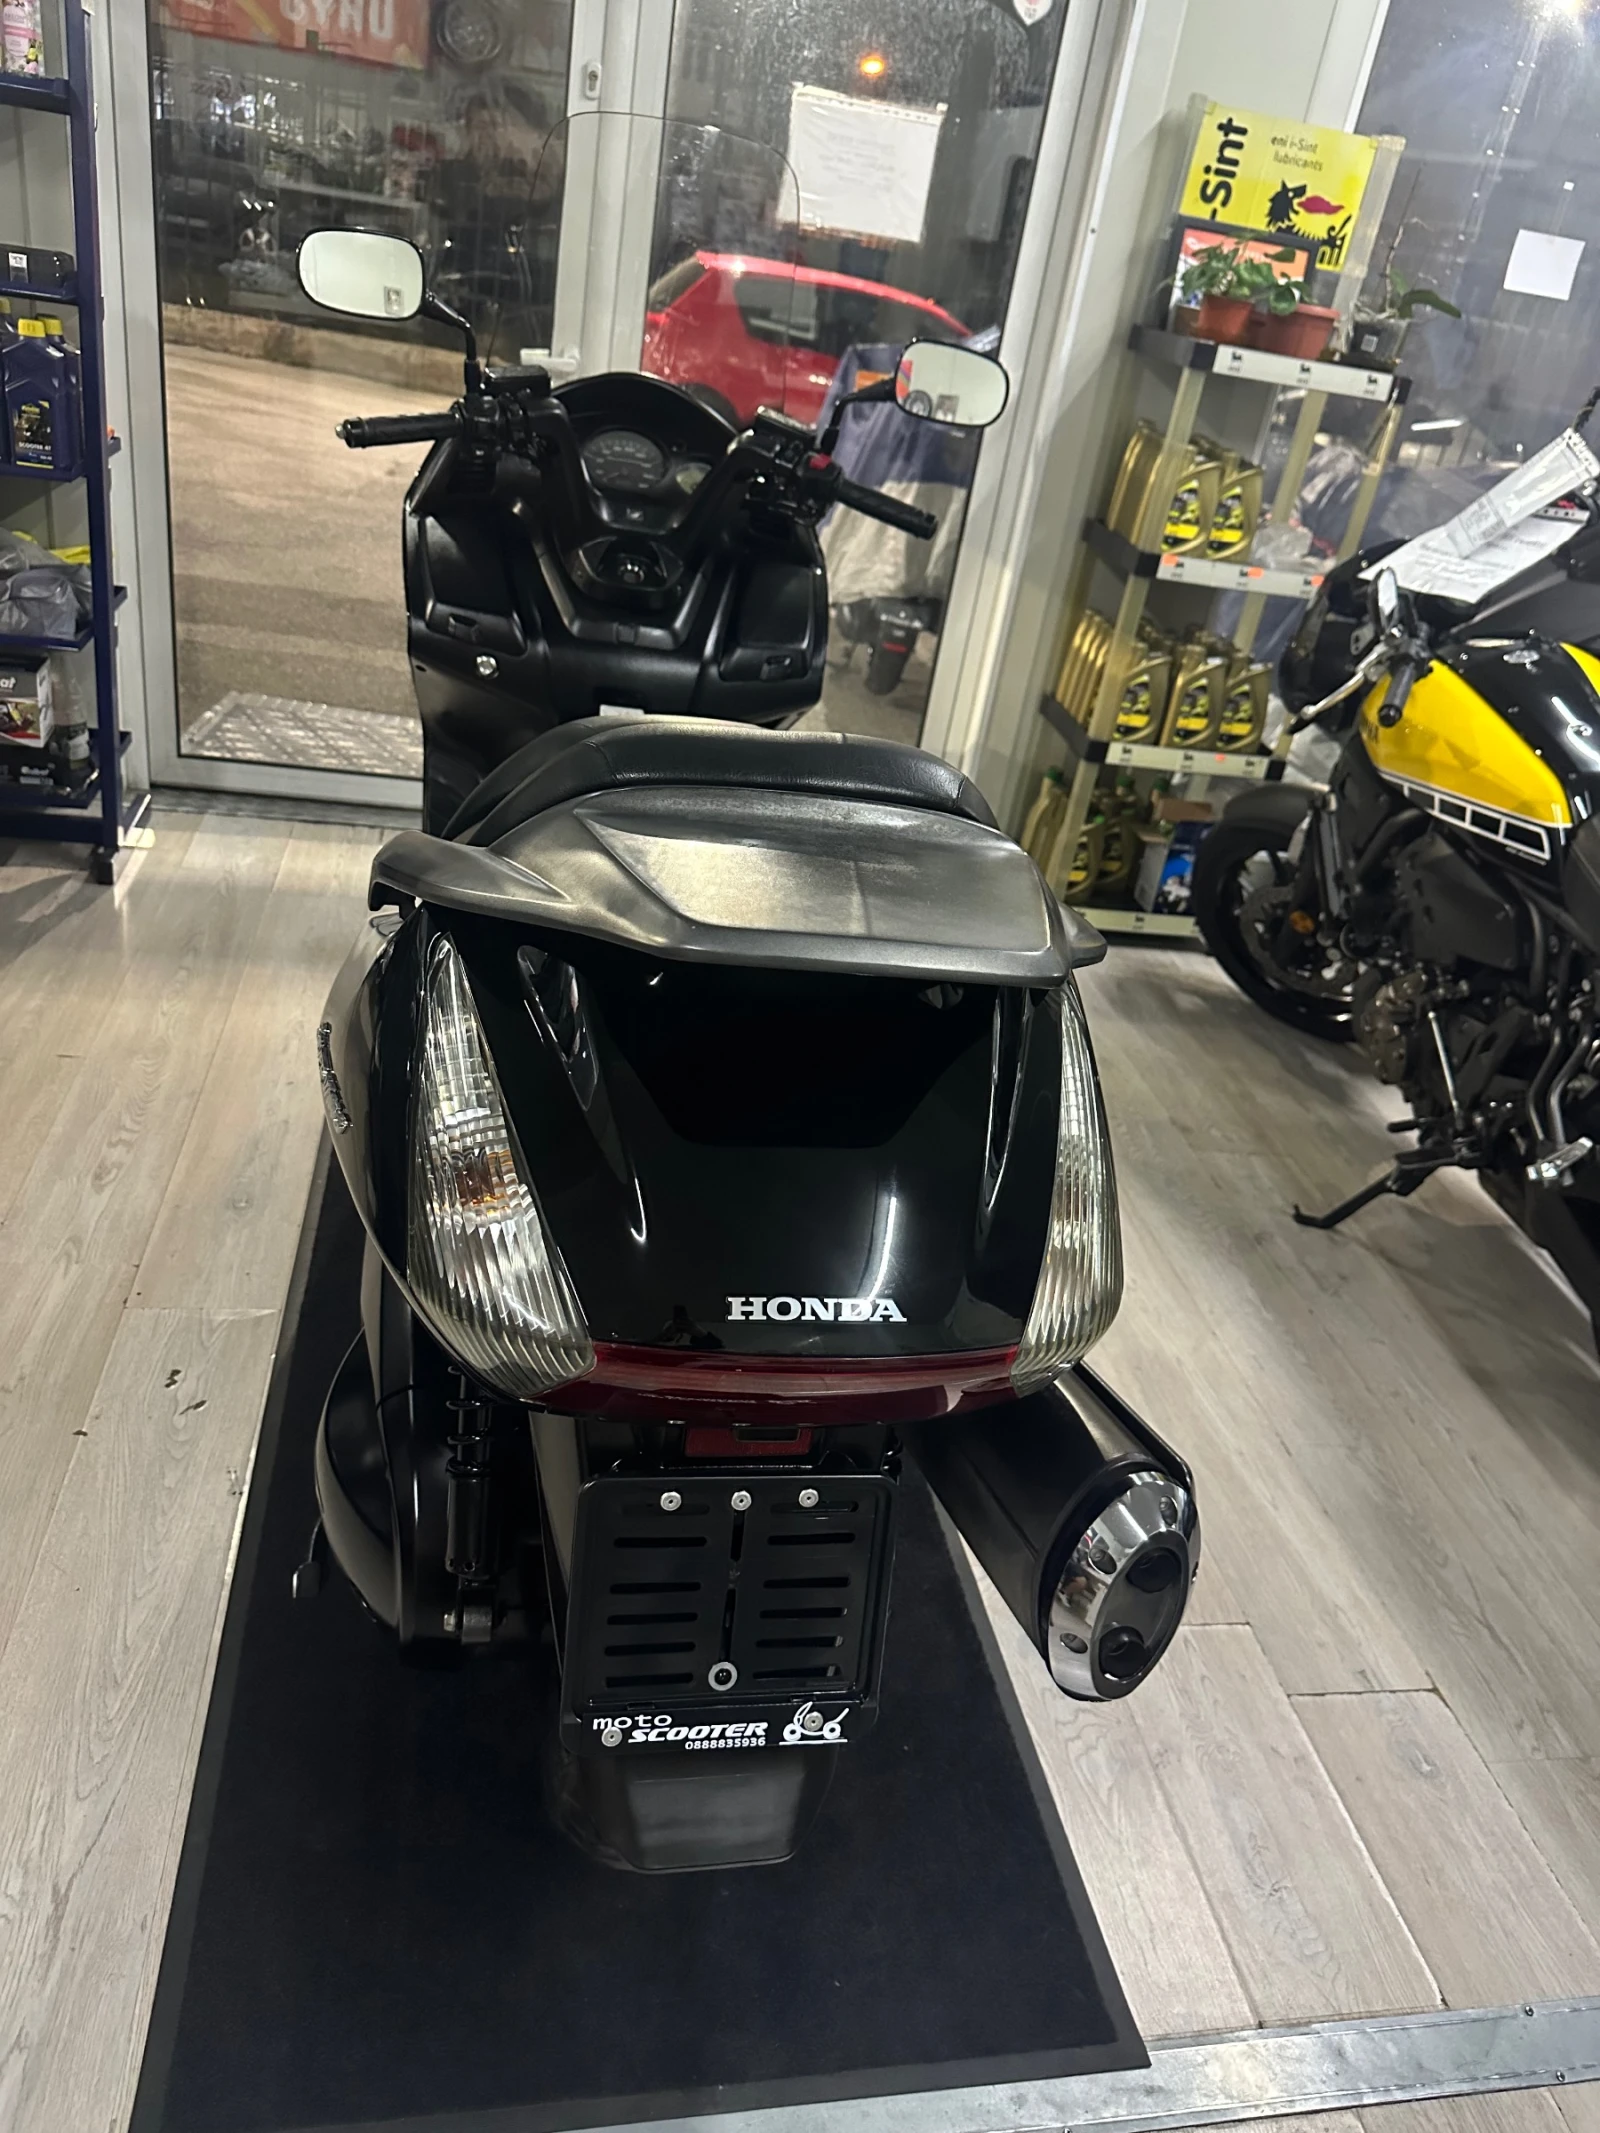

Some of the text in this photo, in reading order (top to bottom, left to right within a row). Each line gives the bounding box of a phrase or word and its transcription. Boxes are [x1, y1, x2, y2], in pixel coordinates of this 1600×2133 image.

[1271, 136, 1318, 154] eni i-Sint
[1200, 117, 1248, 221] -Sint
[1273, 150, 1323, 172] lubricants
[0, 676, 16, 689] at
[727, 1297, 907, 1322] HONDA
[593, 1714, 672, 1730] moto
[628, 1722, 768, 1743] SCOOTER
[685, 1737, 766, 1750] 0888835936
